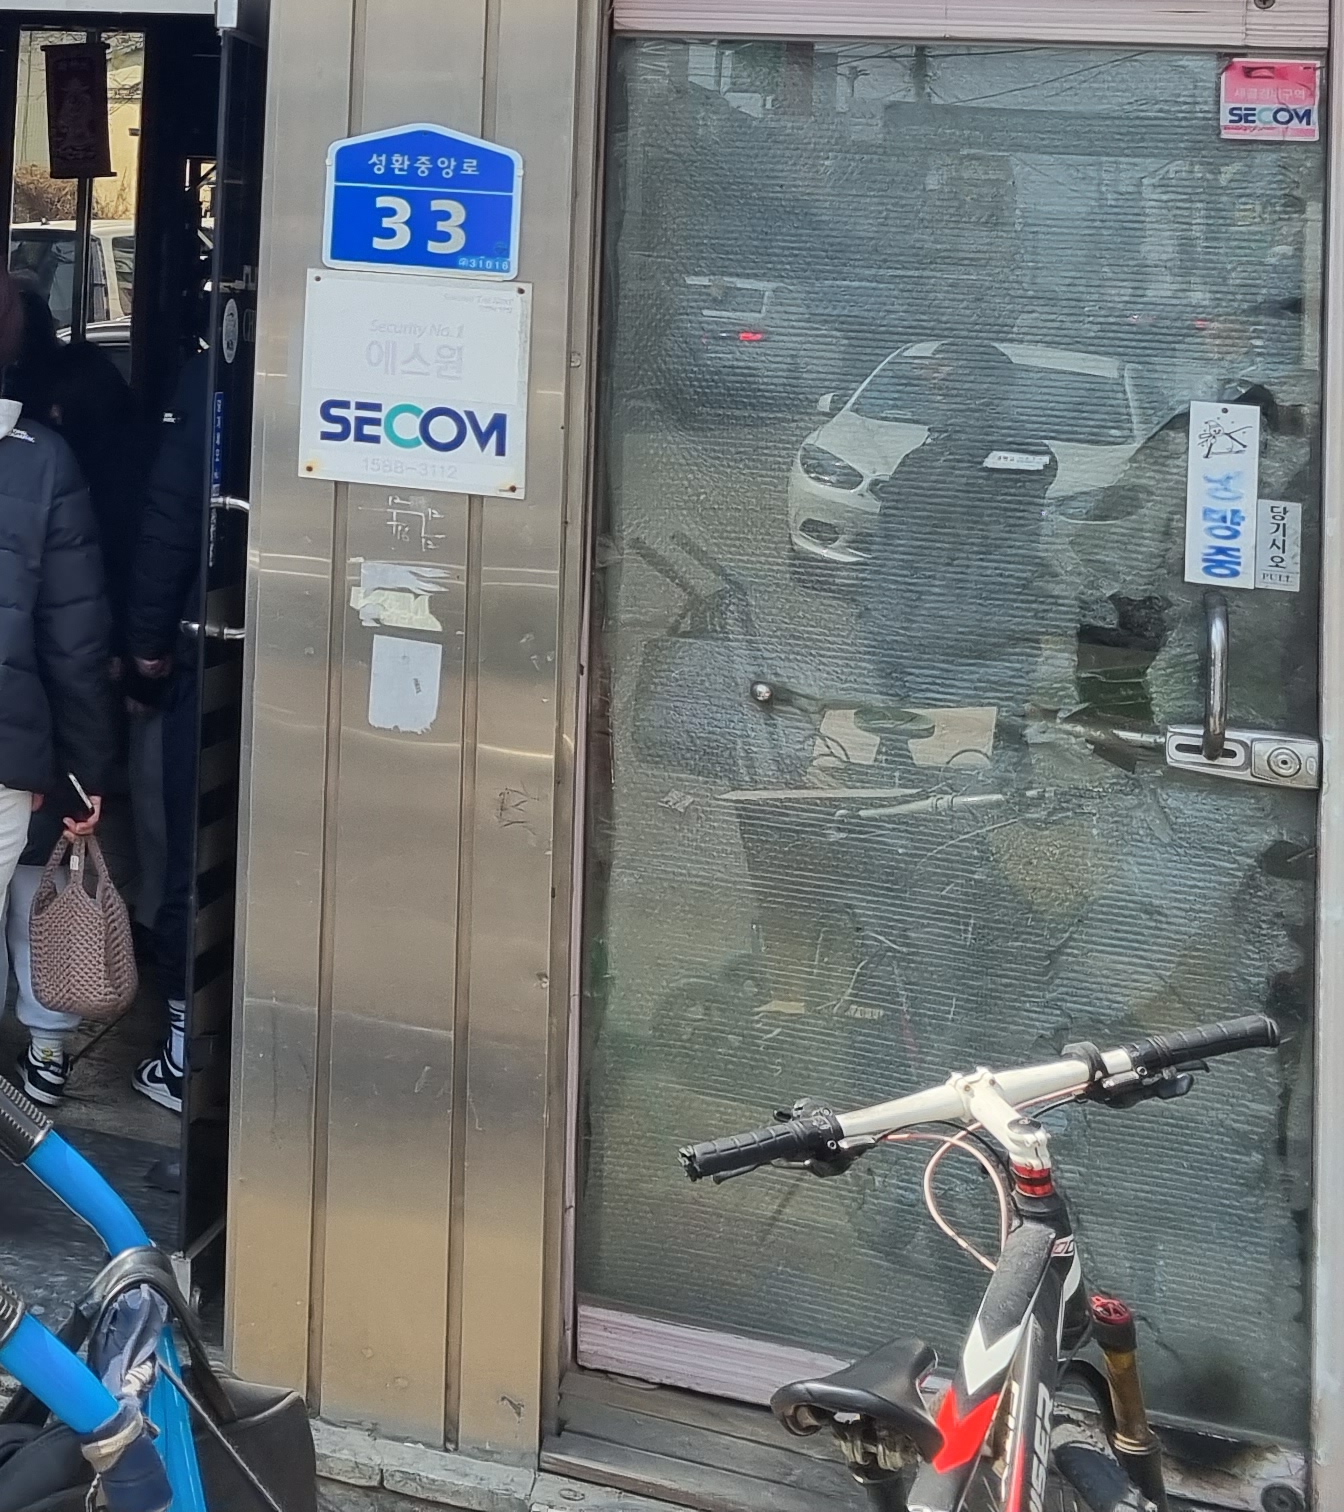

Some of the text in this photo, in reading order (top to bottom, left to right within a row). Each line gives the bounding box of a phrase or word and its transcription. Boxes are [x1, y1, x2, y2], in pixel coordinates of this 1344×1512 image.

[1228, 107, 1312, 126] SECOM
[368, 153, 480, 178] 성환중앙로
[372, 196, 466, 254] 33
[319, 398, 507, 457] SECOM
[1268, 505, 1289, 569] 당기시오
